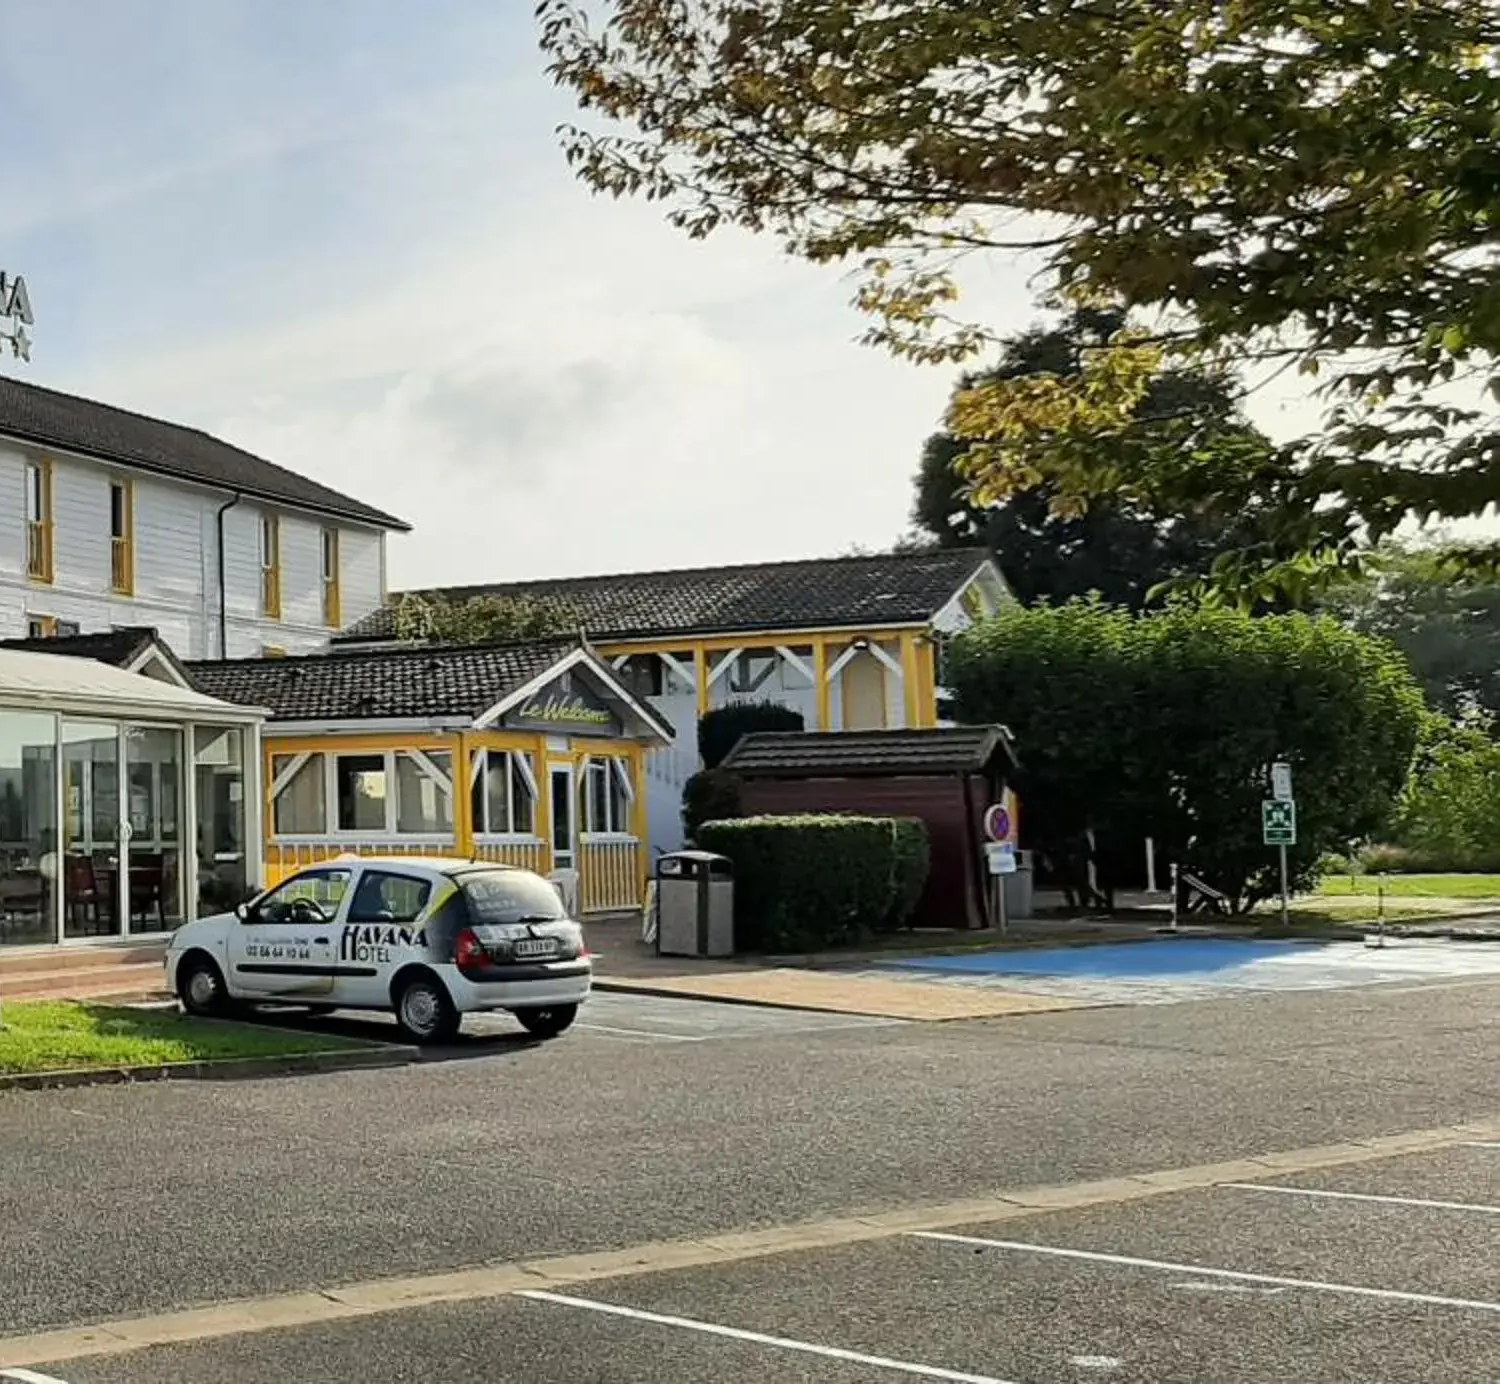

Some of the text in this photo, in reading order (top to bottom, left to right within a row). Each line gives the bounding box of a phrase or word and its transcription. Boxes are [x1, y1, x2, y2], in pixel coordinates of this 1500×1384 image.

[519, 694, 610, 723] Le Welcome
[342, 926, 429, 961] HAVANA
